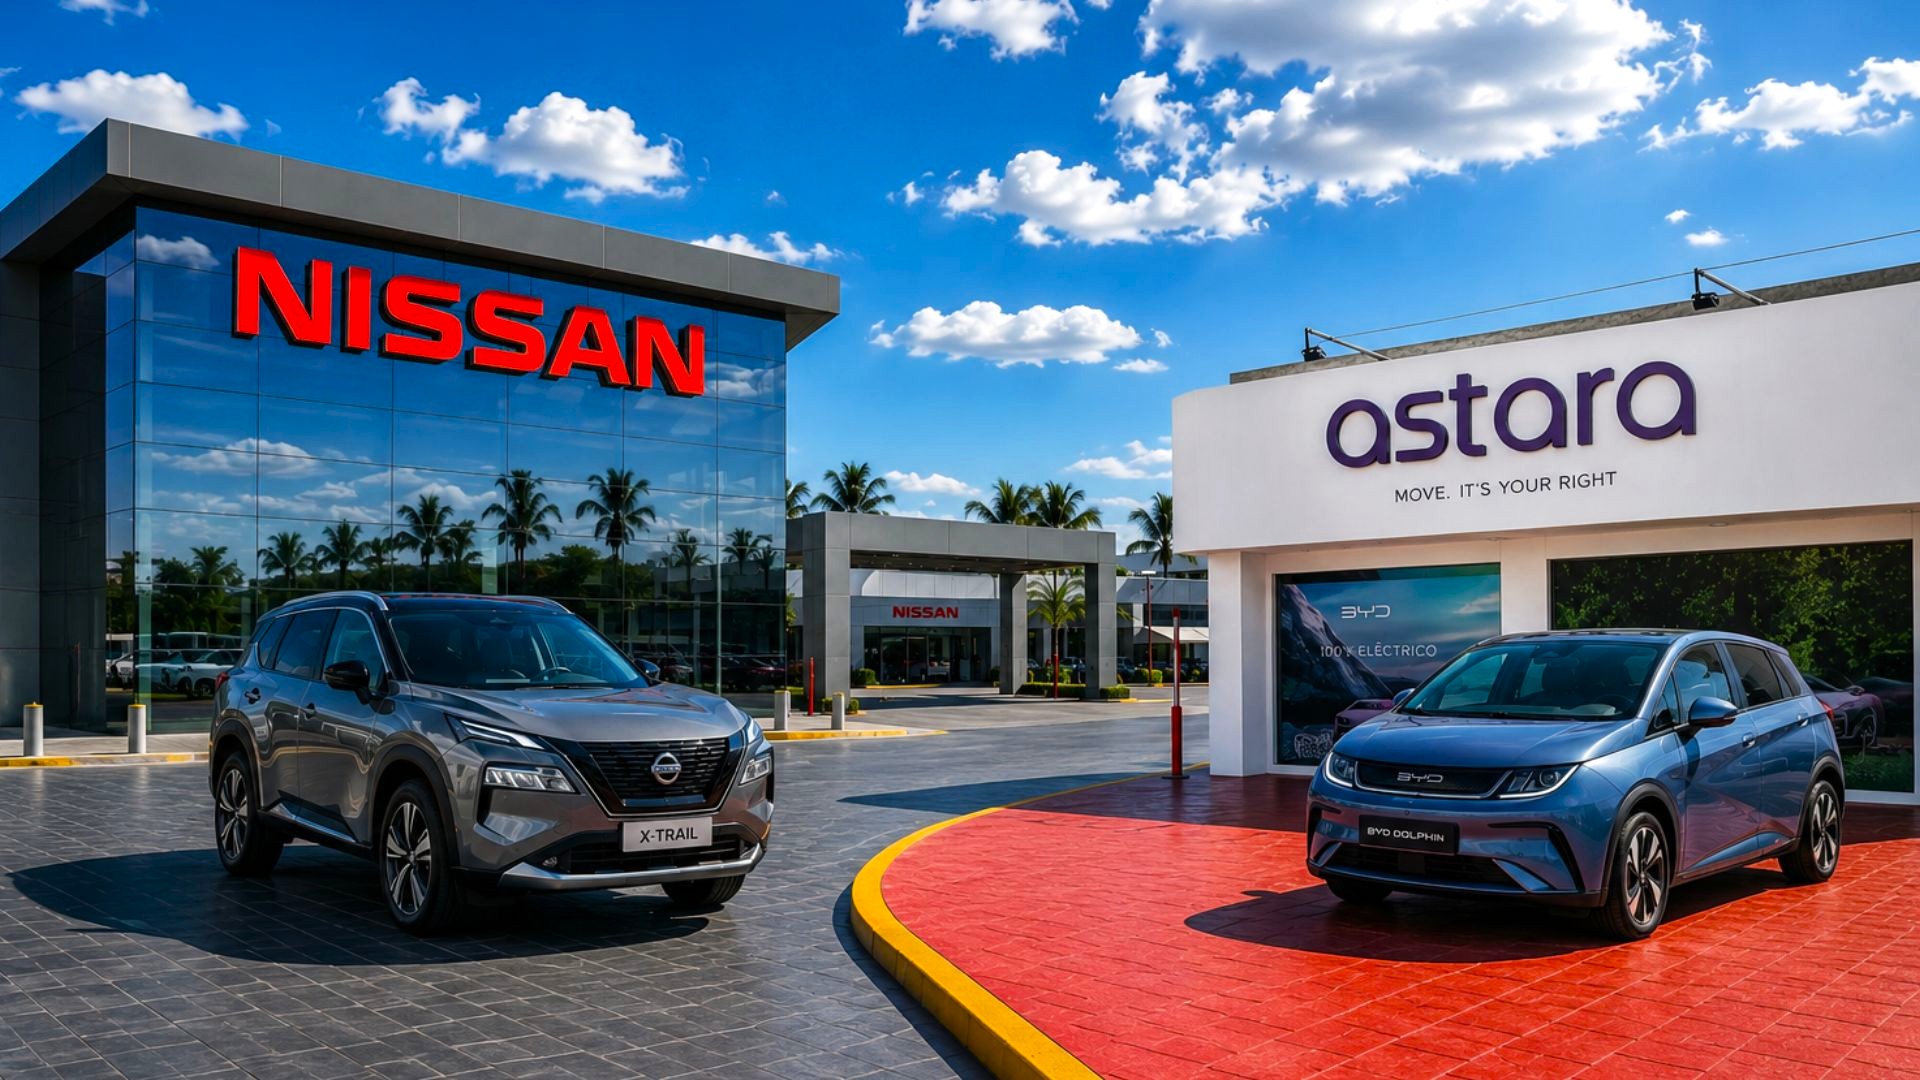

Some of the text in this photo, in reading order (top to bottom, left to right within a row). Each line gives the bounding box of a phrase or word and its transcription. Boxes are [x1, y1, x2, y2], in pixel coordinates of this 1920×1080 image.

[234, 246, 705, 397] NISSAN
[1326, 361, 1697, 468] astara
[1394, 471, 1617, 503] MOVE. IT'S YOUR RIGHT
[892, 606, 959, 618] NISSAN
[1341, 605, 1391, 618] BYD
[1397, 772, 1443, 783] BYD
[640, 828, 698, 843] X-TRAIL
[1367, 827, 1445, 842] BYD DOLPHIN
